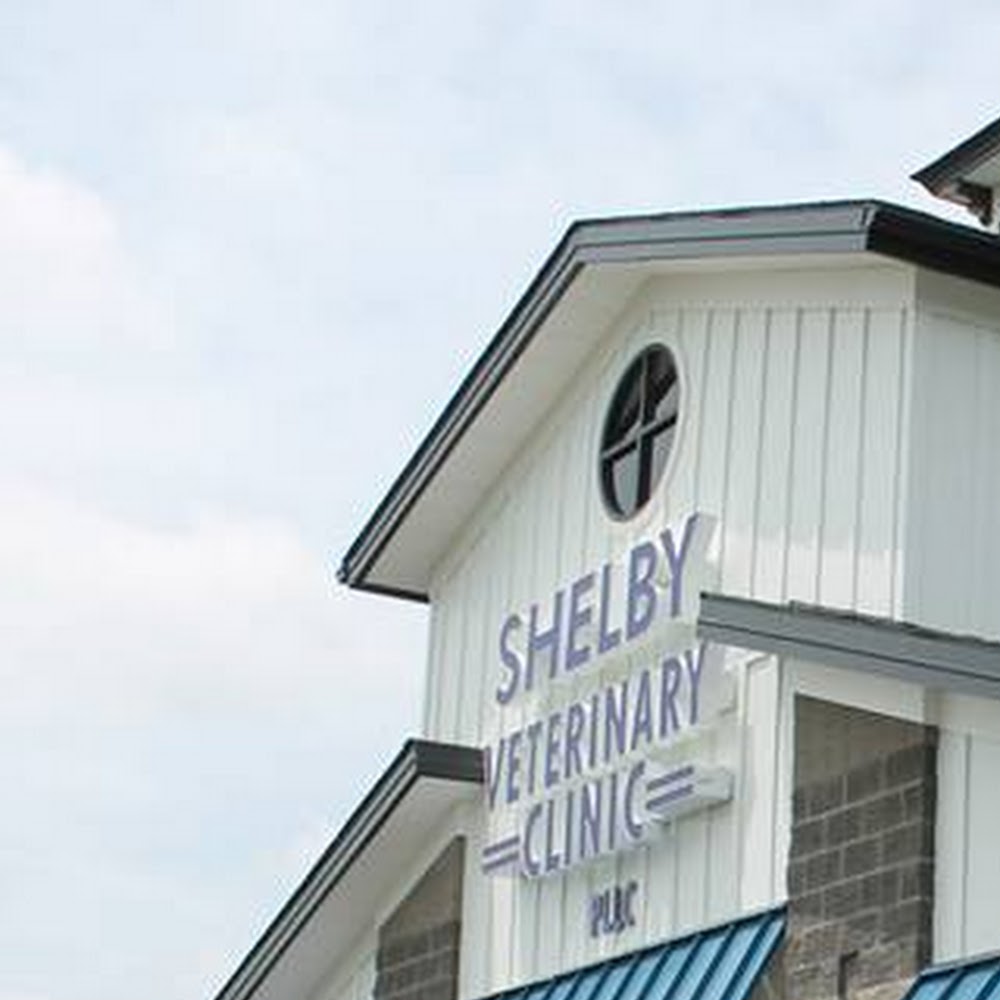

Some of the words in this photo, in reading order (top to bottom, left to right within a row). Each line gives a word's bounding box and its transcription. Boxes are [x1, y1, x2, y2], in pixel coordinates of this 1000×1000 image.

[496, 511, 700, 704] SHELBY
[484, 645, 706, 810] VETERINARY
[521, 760, 646, 876] CLINIC
